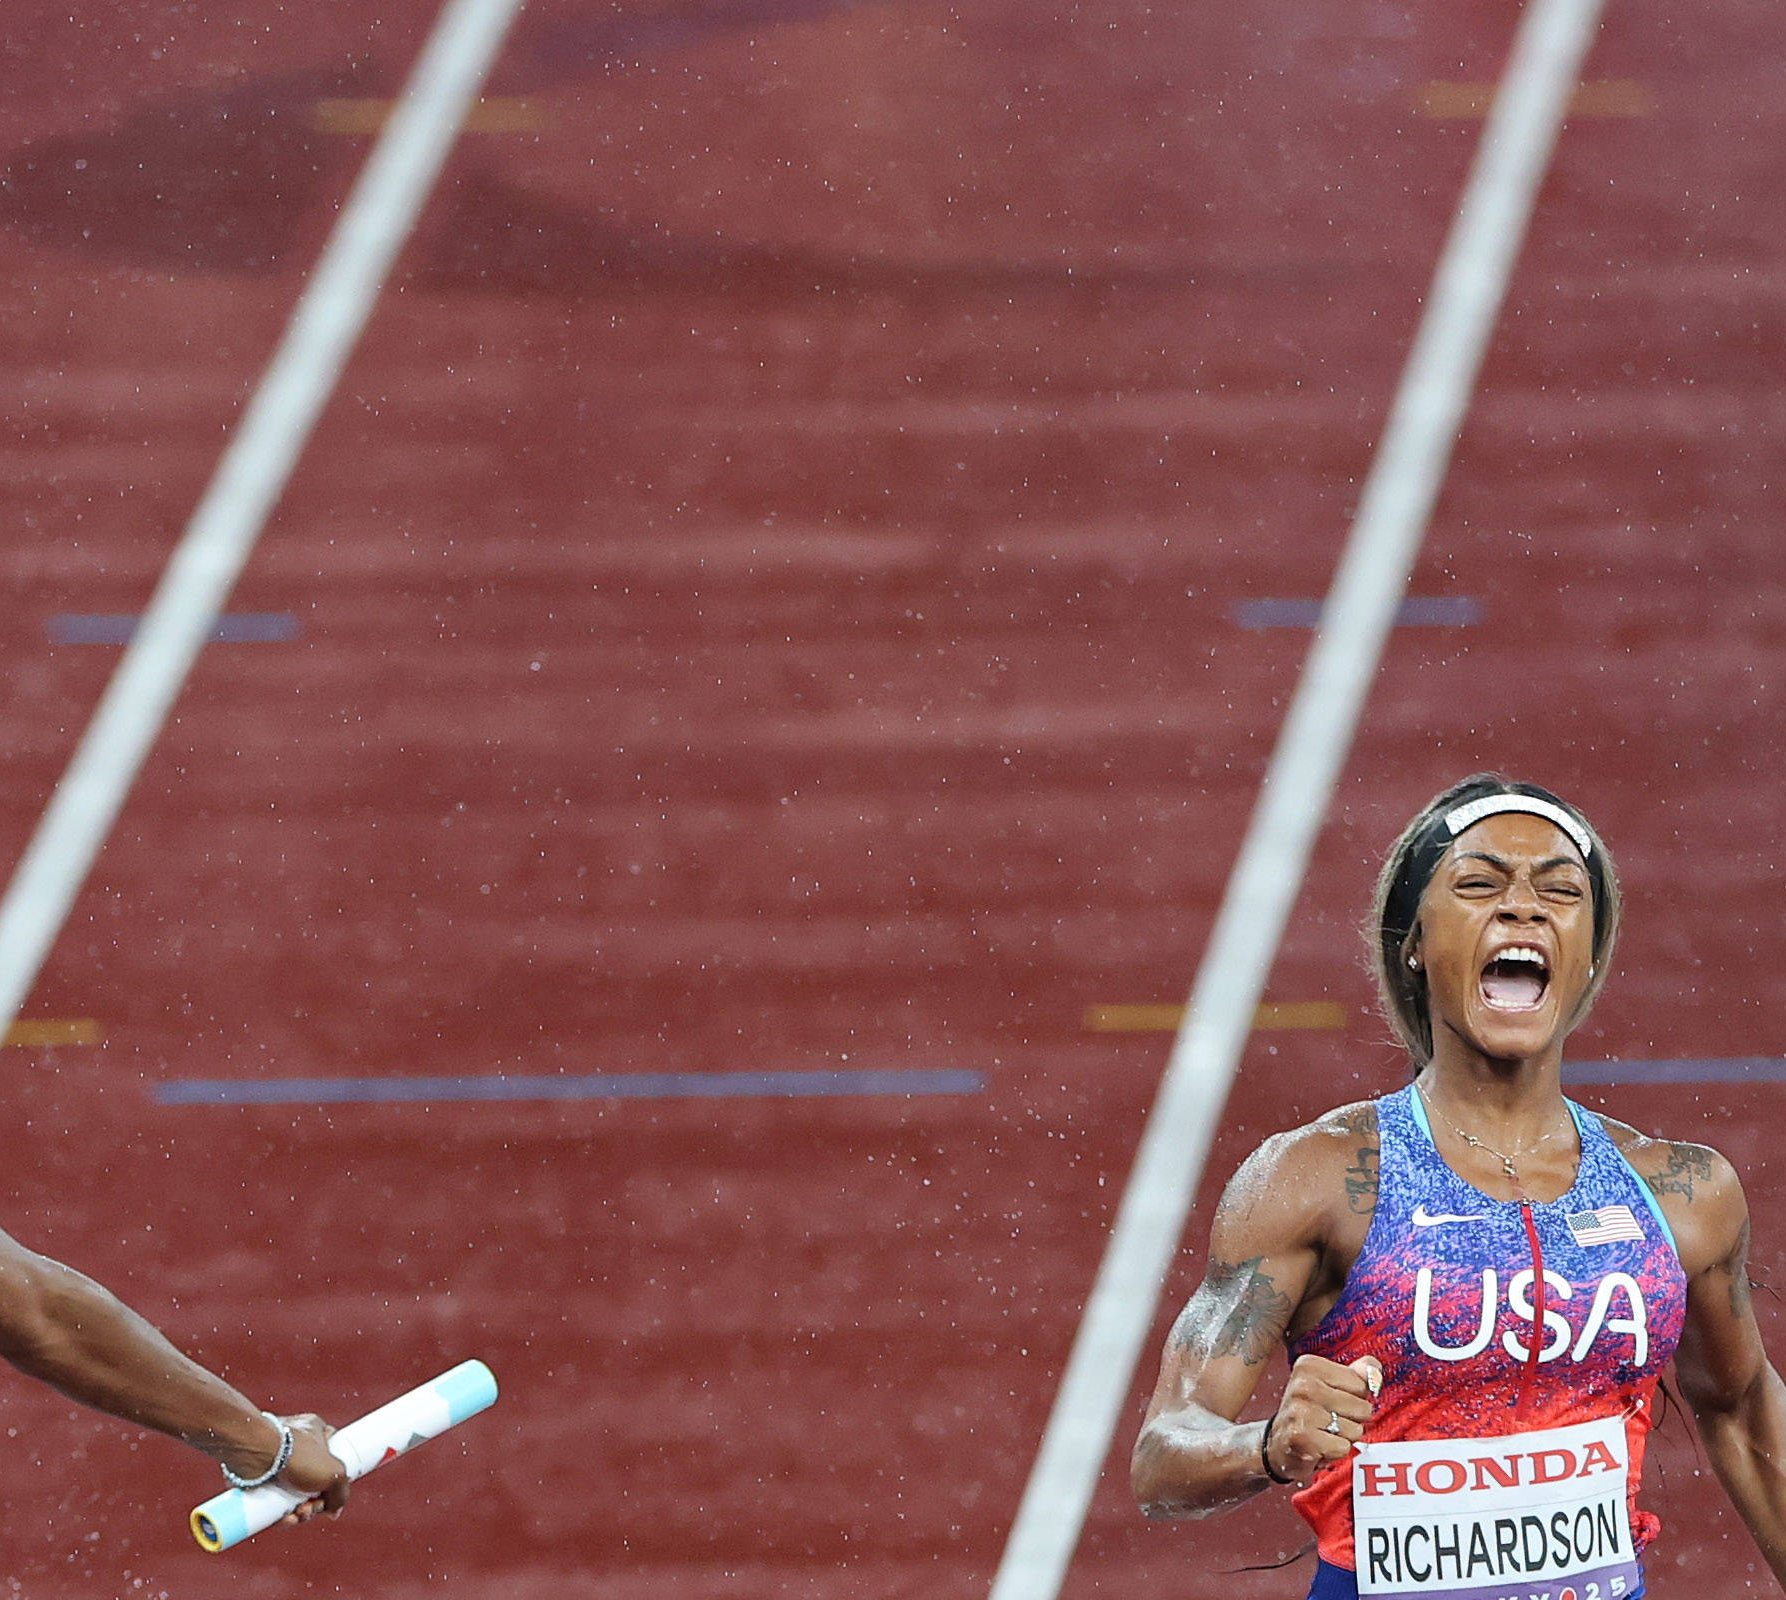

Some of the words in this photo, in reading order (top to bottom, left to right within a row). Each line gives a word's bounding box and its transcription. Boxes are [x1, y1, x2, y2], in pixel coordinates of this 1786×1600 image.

[1413, 1268, 1649, 1367] USA
[1359, 1441, 1621, 1498] HONDA
[1368, 1499, 1619, 1584] RICHARDSON
